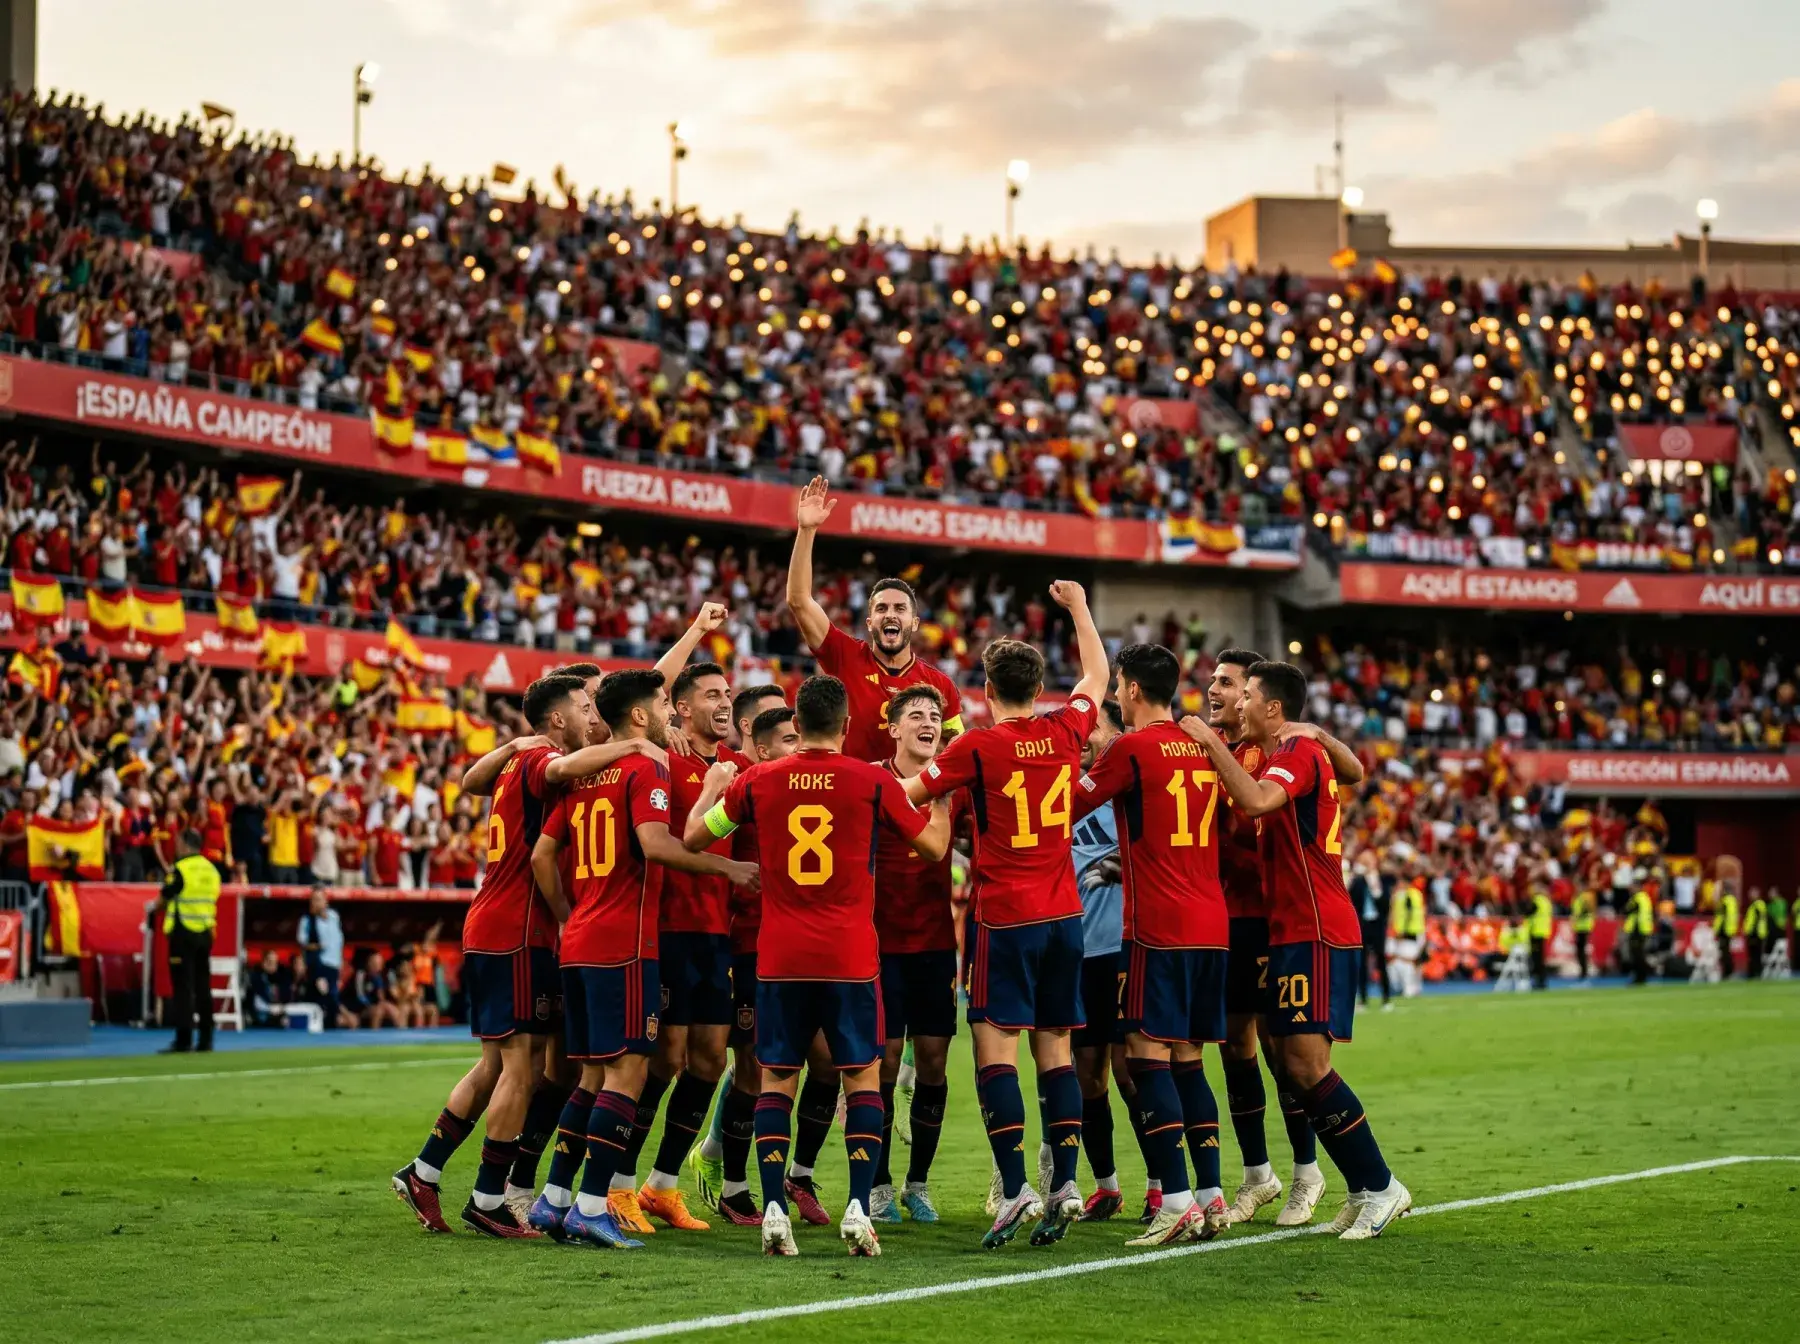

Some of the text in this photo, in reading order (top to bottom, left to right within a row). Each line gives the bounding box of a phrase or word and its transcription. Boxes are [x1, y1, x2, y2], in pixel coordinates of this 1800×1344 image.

[77, 381, 332, 454] ¡ESPAÑA CAMPEÓN!
[582, 464, 668, 506] FUERZA
[851, 502, 1047, 546] ¡VAMOS ESPAÑA!
[1402, 570, 1578, 602] AQUÍ ESTAMOS
[1700, 578, 1764, 610] AQUÍ
[1015, 737, 1054, 758] GAVI
[788, 773, 835, 790] KOKE
[1567, 756, 1789, 783] SELECCIÓN ESPAÑOLA
[1001, 764, 1071, 848] 14
[1165, 769, 1218, 847] 17
[1325, 779, 1341, 855] 2
[570, 798, 616, 880] 10
[788, 805, 833, 885] 8
[1277, 974, 1309, 1008] 20
